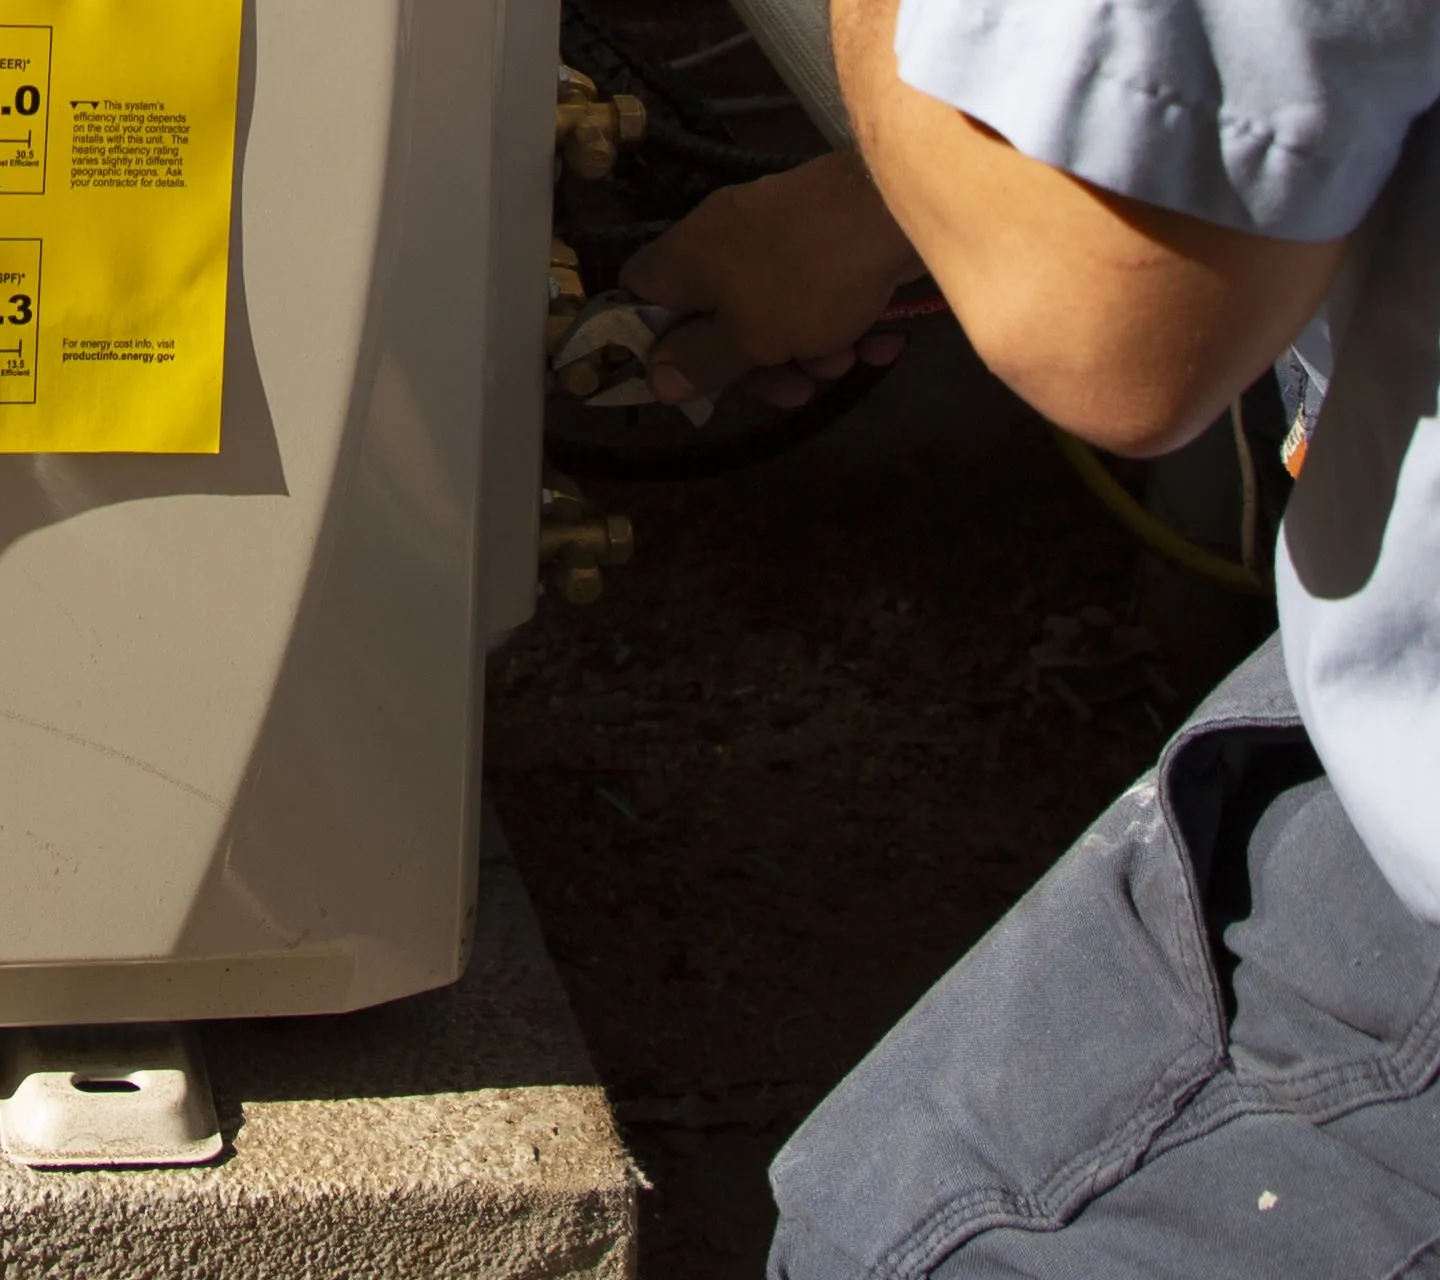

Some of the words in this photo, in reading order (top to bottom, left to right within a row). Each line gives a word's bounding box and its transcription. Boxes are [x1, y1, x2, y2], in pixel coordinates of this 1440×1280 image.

[104, 100, 122, 110] This
[125, 102, 164, 112] system's
[74, 113, 116, 123] efficiency
[119, 114, 144, 124] rating
[147, 114, 186, 123] depends
[87, 124, 101, 132] the
[104, 124, 120, 132] coil
[122, 126, 142, 134] your
[145, 125, 190, 133] contractor
[73, 135, 104, 144] installs
[107, 135, 124, 144] with
[128, 135, 143, 144] this
[171, 135, 189, 144] The
[16, 150, 34, 159] 30.5
[72, 145, 105, 156] heating
[108, 146, 150, 156] efficiency
[153, 146, 178, 157] rating
[10, 159, 39, 167] Efficient
[72, 157, 98, 165] varies
[101, 156, 133, 168] slightly
[135, 157, 143, 165] in
[146, 157, 183, 166] different
[71, 167, 121, 177] geographic
[165, 168, 182, 177] Ask
[71, 180, 90, 189] your
[93, 179, 137, 188] contractor
[141, 179, 152, 187] for
[155, 179, 187, 188] details.
[62, 339, 78, 348] For
[80, 341, 111, 350] energy
[114, 339, 133, 349] cost
[135, 339, 154, 350] info,
[157, 339, 174, 349] visit
[62, 351, 175, 363] productinfo.energy.gov
[7, 360, 24, 369] 13.5
